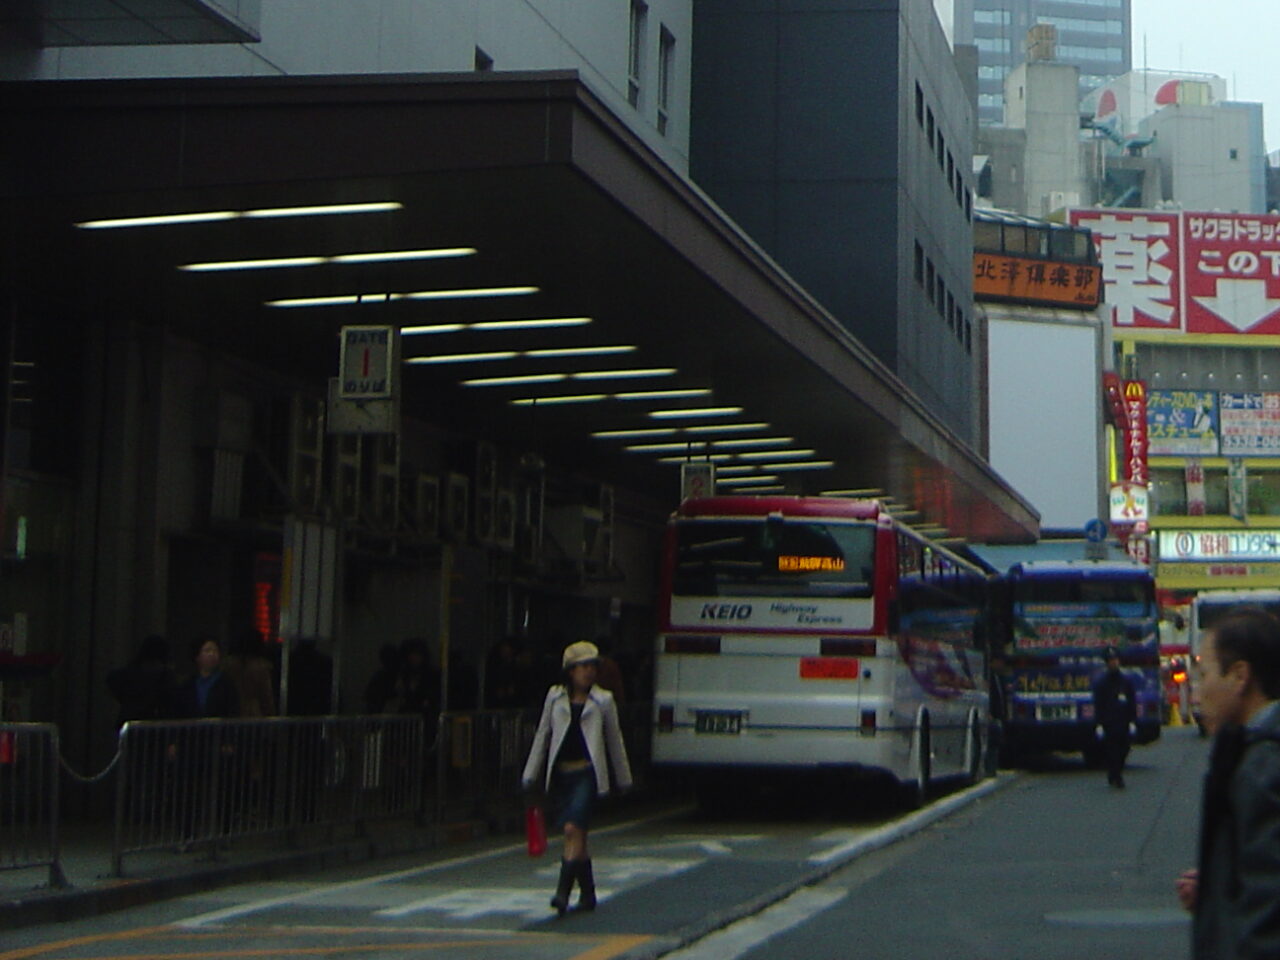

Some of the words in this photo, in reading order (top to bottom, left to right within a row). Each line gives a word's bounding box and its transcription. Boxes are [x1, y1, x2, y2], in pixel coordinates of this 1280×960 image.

[1079, 214, 1175, 328] 薬
[700, 603, 753, 620] KEIO
[769, 602, 818, 615] Highway
[796, 614, 843, 624] Express
